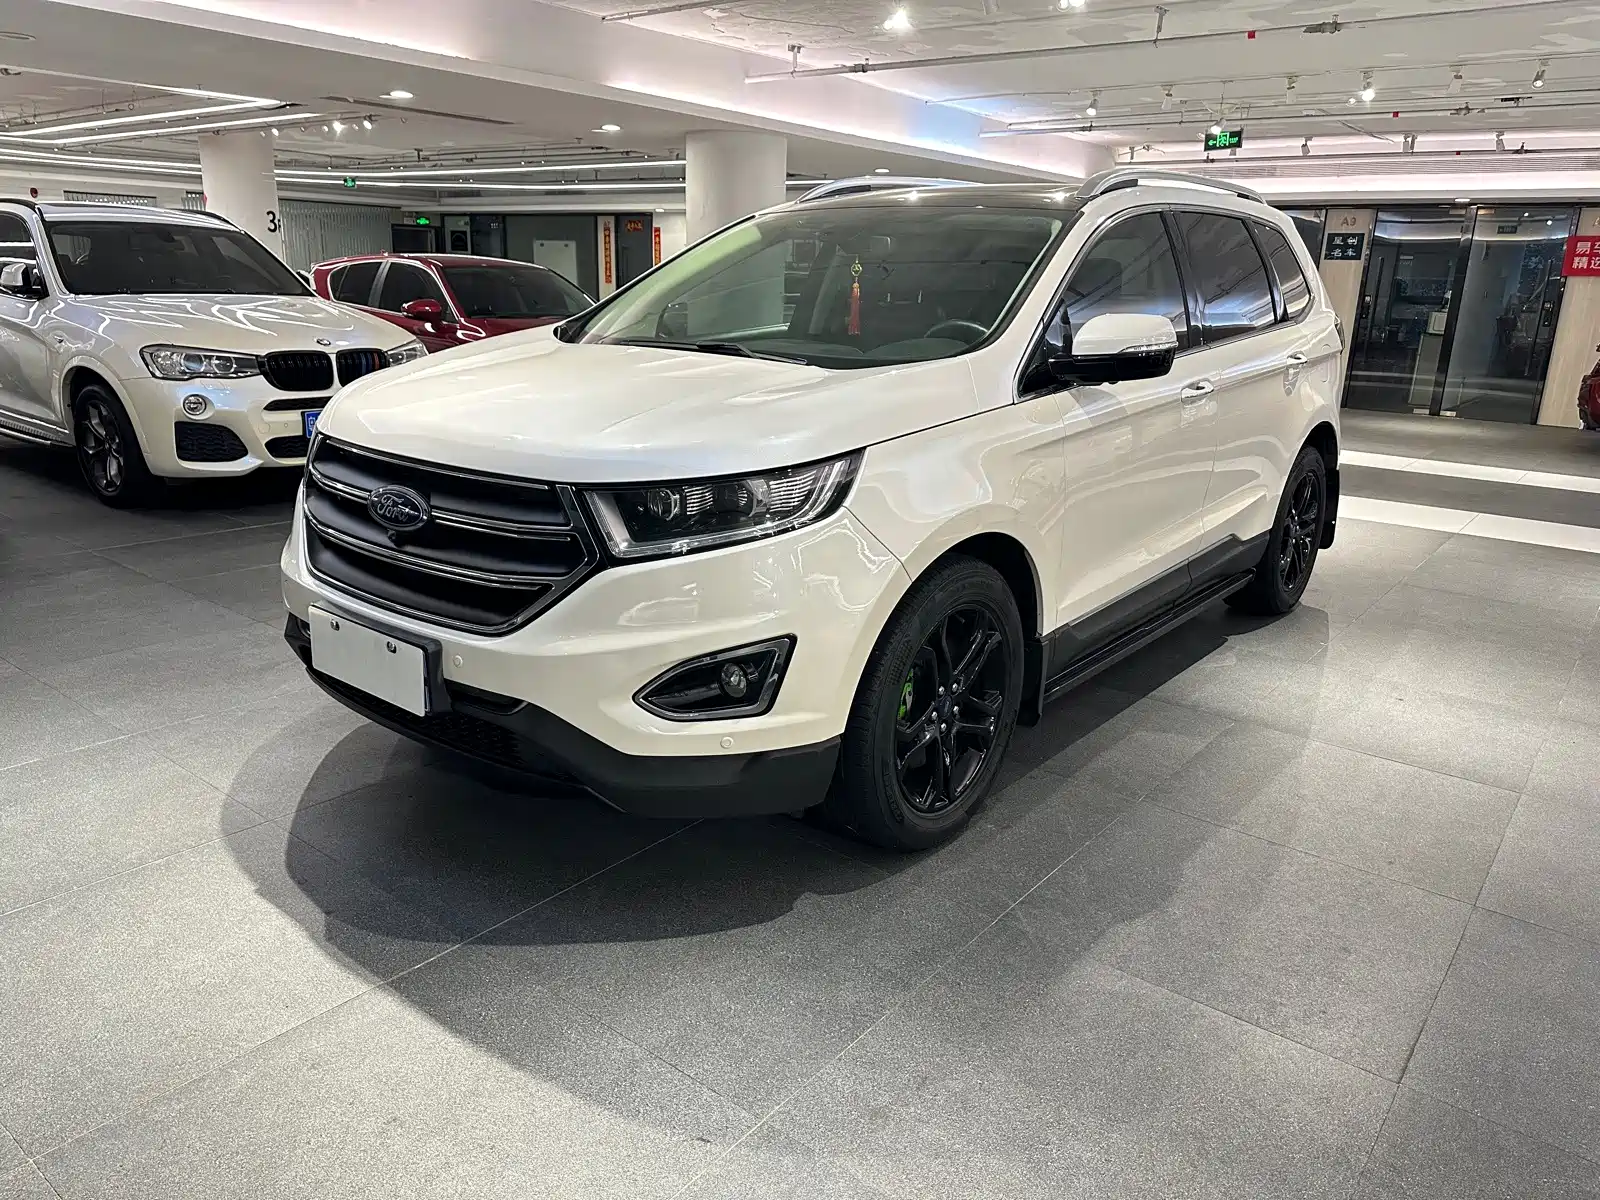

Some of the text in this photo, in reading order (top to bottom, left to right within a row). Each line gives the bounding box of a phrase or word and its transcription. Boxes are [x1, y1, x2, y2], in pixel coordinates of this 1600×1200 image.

[1341, 216, 1357, 227] A9
[1330, 248, 1357, 257] 名车
[377, 494, 418, 521] Ford
